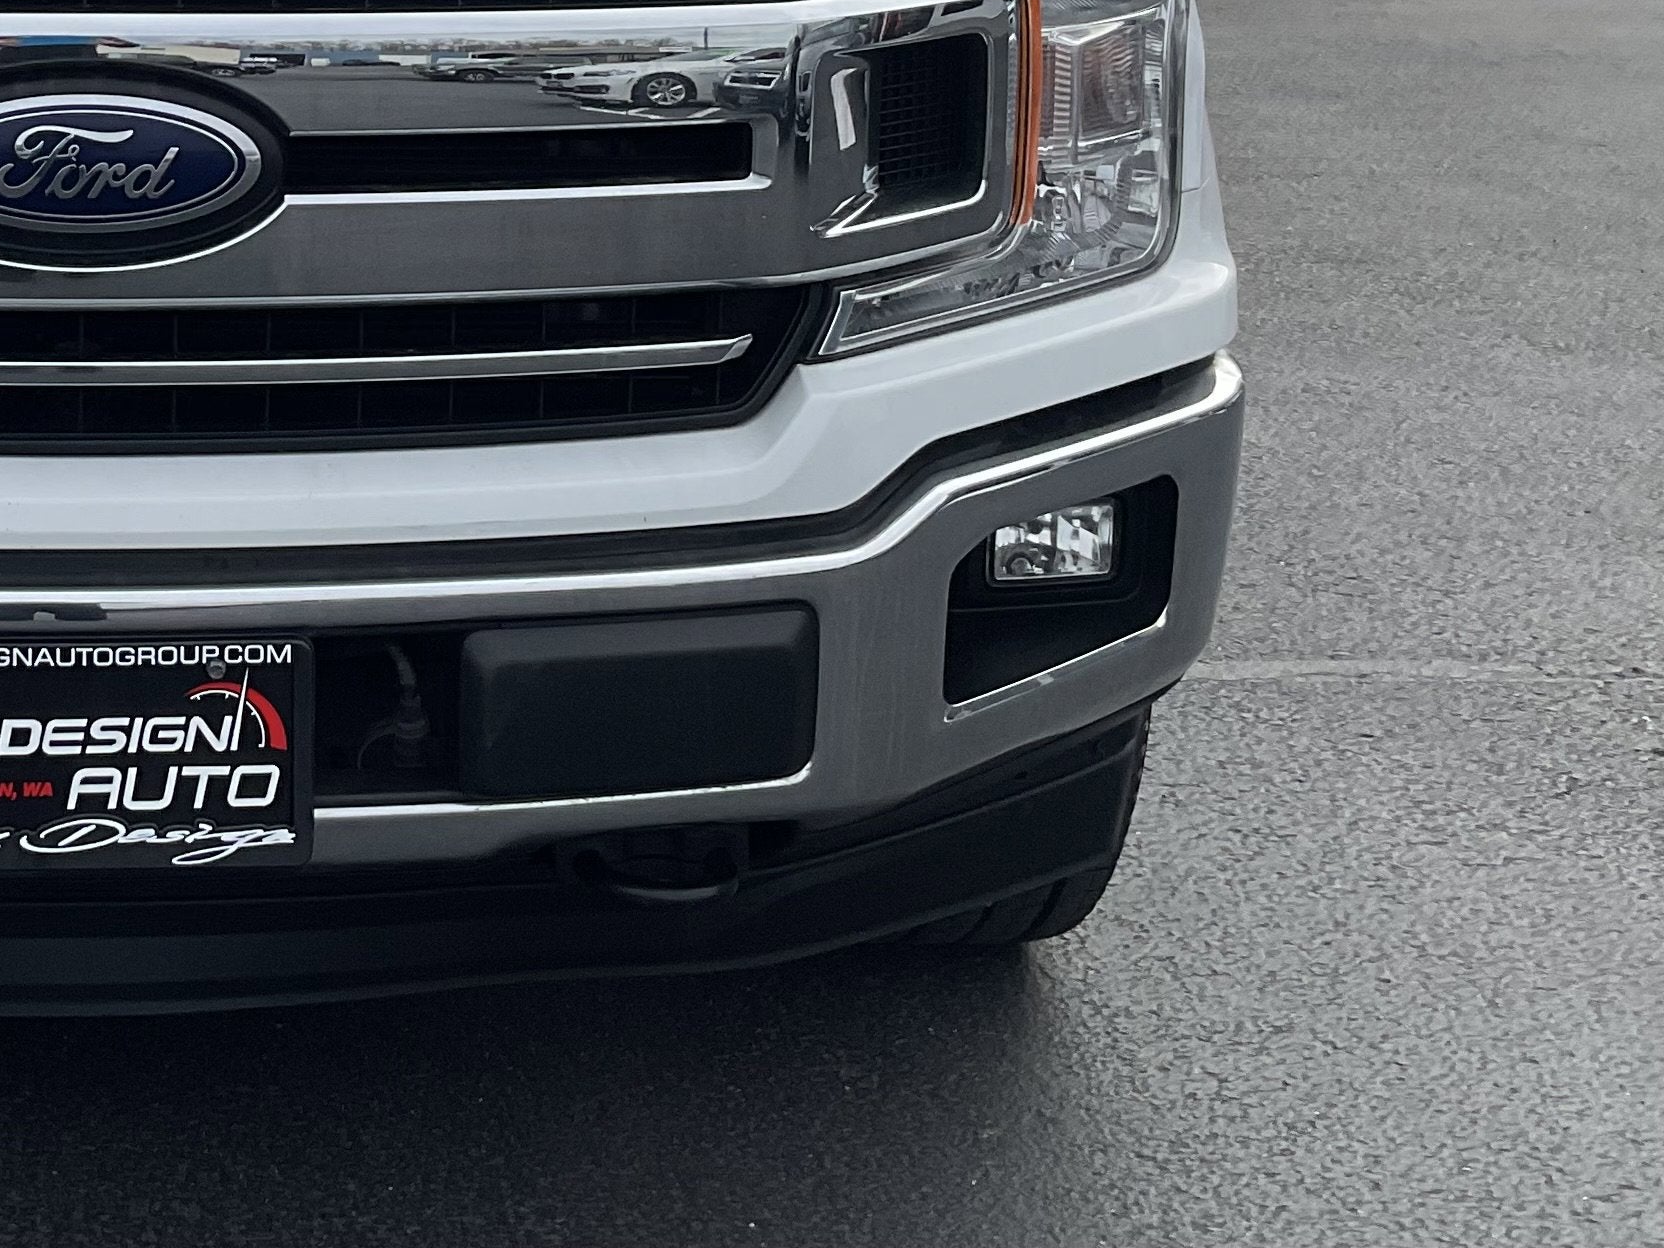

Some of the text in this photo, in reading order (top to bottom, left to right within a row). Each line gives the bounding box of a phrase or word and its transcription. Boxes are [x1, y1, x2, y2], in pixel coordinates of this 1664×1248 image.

[22, 782, 53, 798] WA
[66, 764, 281, 811] AUTO
[20, 818, 296, 865] Design
